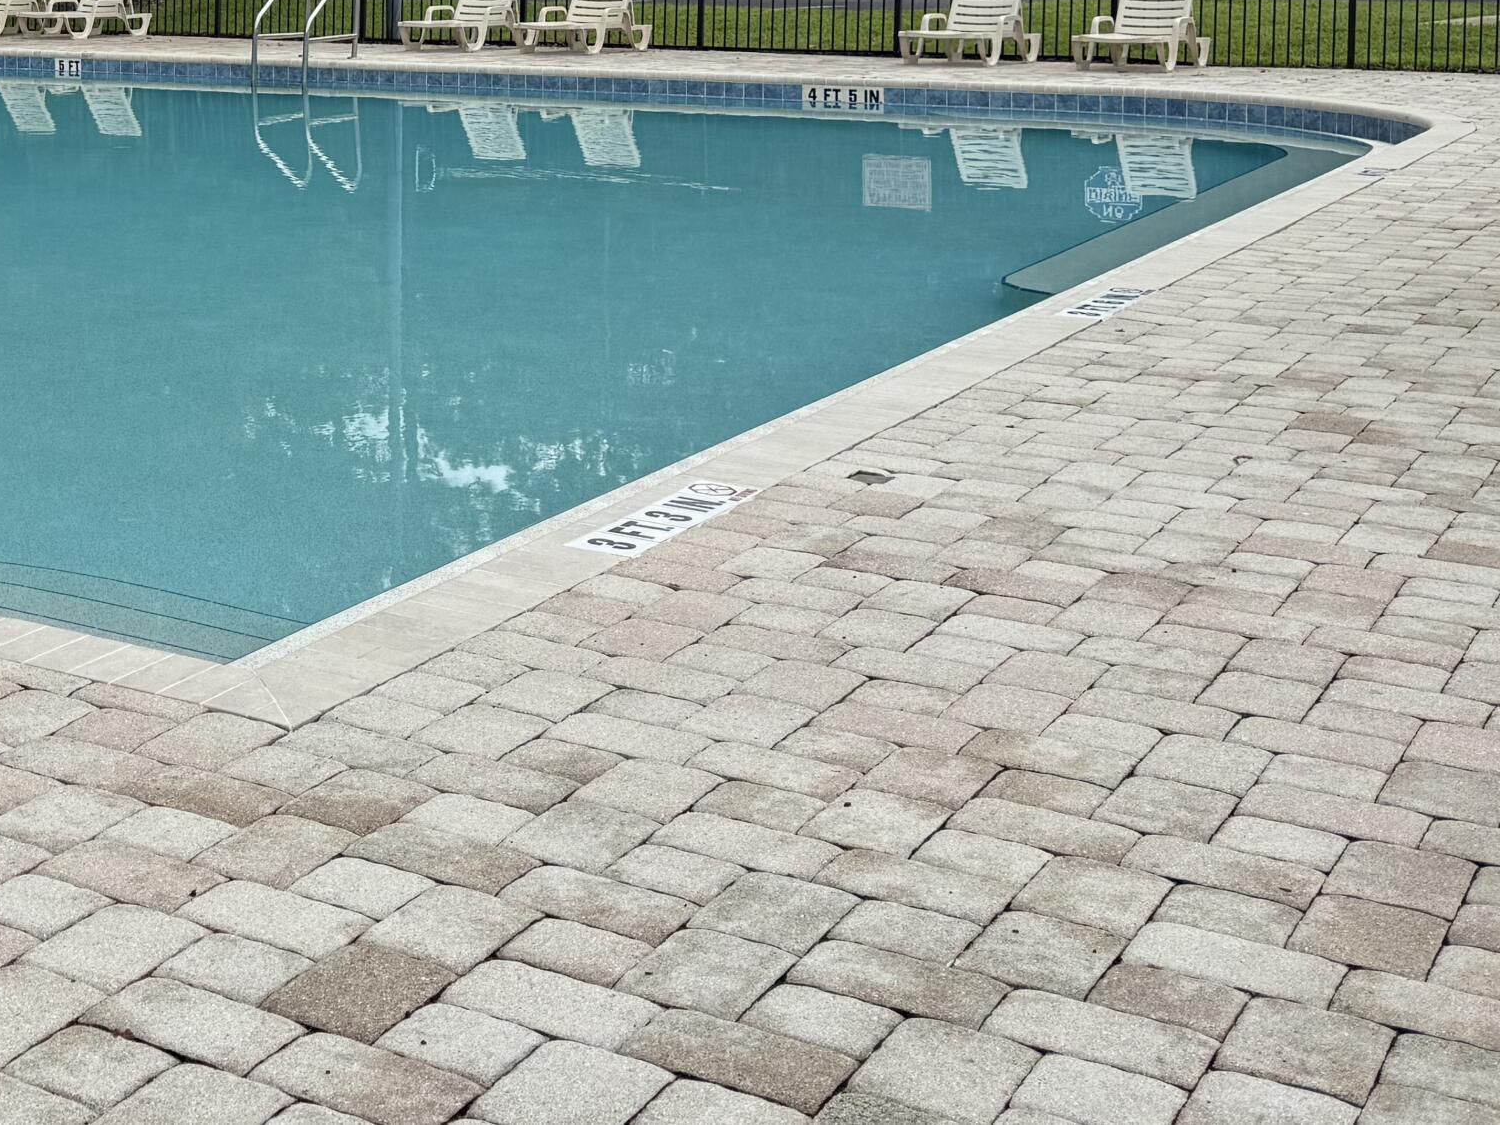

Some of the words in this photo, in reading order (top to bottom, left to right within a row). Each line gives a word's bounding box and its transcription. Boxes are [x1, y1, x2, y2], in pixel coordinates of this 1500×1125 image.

[808, 88, 817, 101] 4
[848, 89, 857, 103] 5
[662, 496, 727, 513] IN.
[644, 510, 693, 522] 3
[608, 520, 675, 540] FT.
[587, 538, 637, 550] 3
